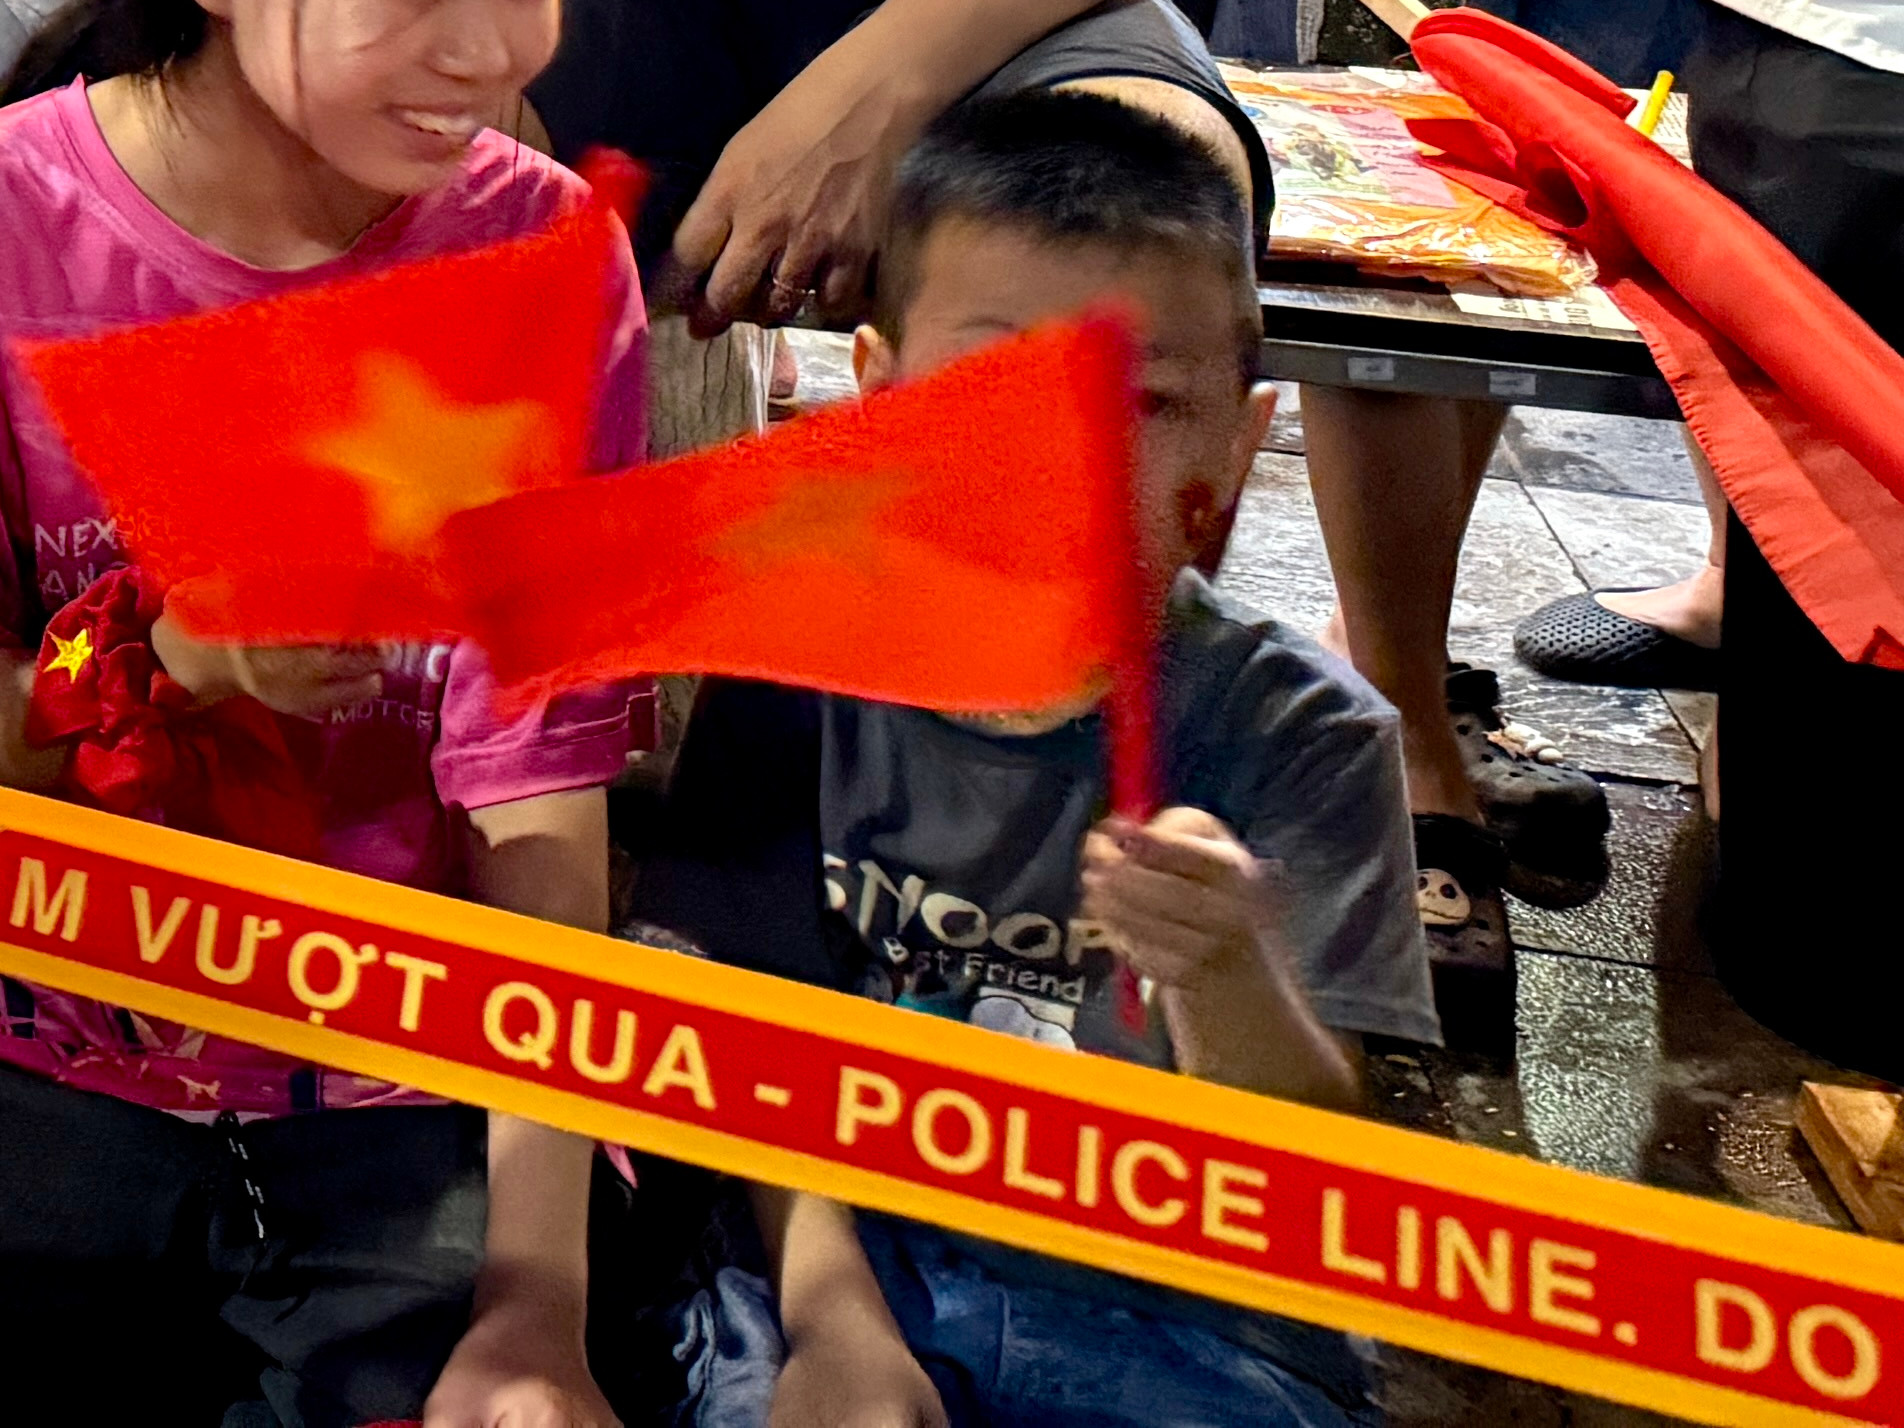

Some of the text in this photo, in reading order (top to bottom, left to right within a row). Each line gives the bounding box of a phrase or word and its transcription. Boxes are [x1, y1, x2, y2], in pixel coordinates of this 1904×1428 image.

[128, 885, 448, 1033] VƯỢT
[482, 980, 718, 1110] QUA
[835, 1065, 1270, 1253] POLICE
[1321, 1187, 1638, 1346] LINE.
[1694, 1277, 1882, 1400] DO
